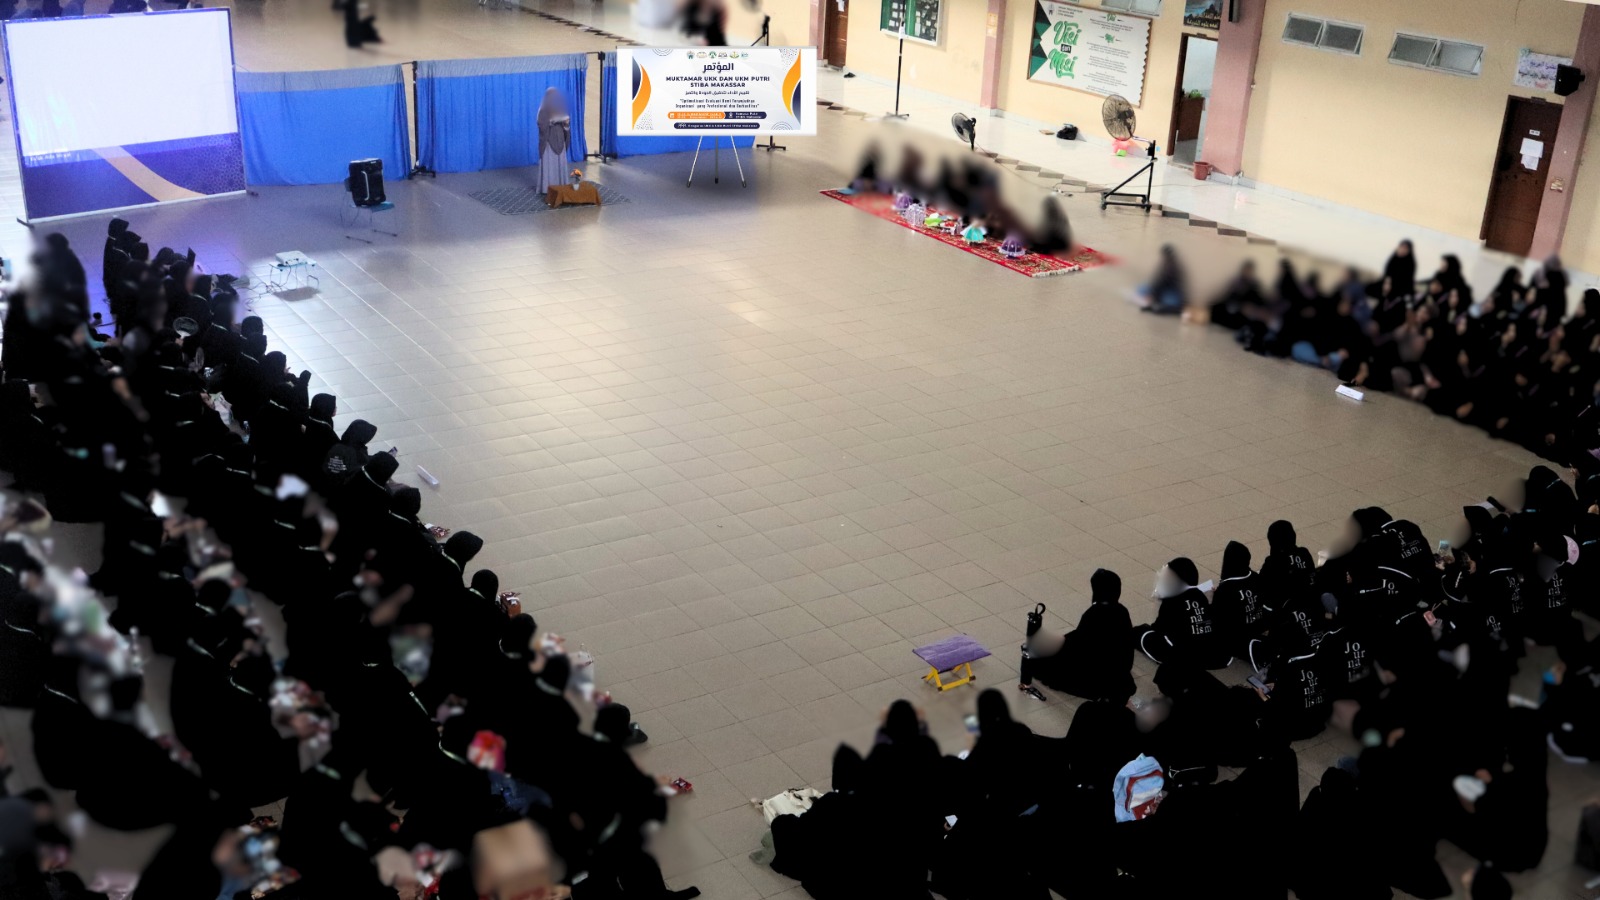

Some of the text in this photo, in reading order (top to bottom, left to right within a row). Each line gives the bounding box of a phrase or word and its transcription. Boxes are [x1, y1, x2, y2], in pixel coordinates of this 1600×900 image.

[1053, 20, 1082, 46] Visi
[703, 62, 734, 73] المؤتمر
[1048, 48, 1078, 79] Misi
[1289, 555, 1301, 565] Jo
[1239, 589, 1253, 601] Jo
[1185, 600, 1199, 611] Jo
[1194, 607, 1204, 615] ur
[1190, 614, 1203, 623] na
[1292, 611, 1306, 622] Jo
[1191, 624, 1212, 634] lism
[1344, 642, 1361, 654] Jo
[1353, 650, 1366, 659] ur
[1347, 659, 1361, 668] na
[1300, 669, 1314, 681] Jo
[1308, 677, 1318, 687] ur
